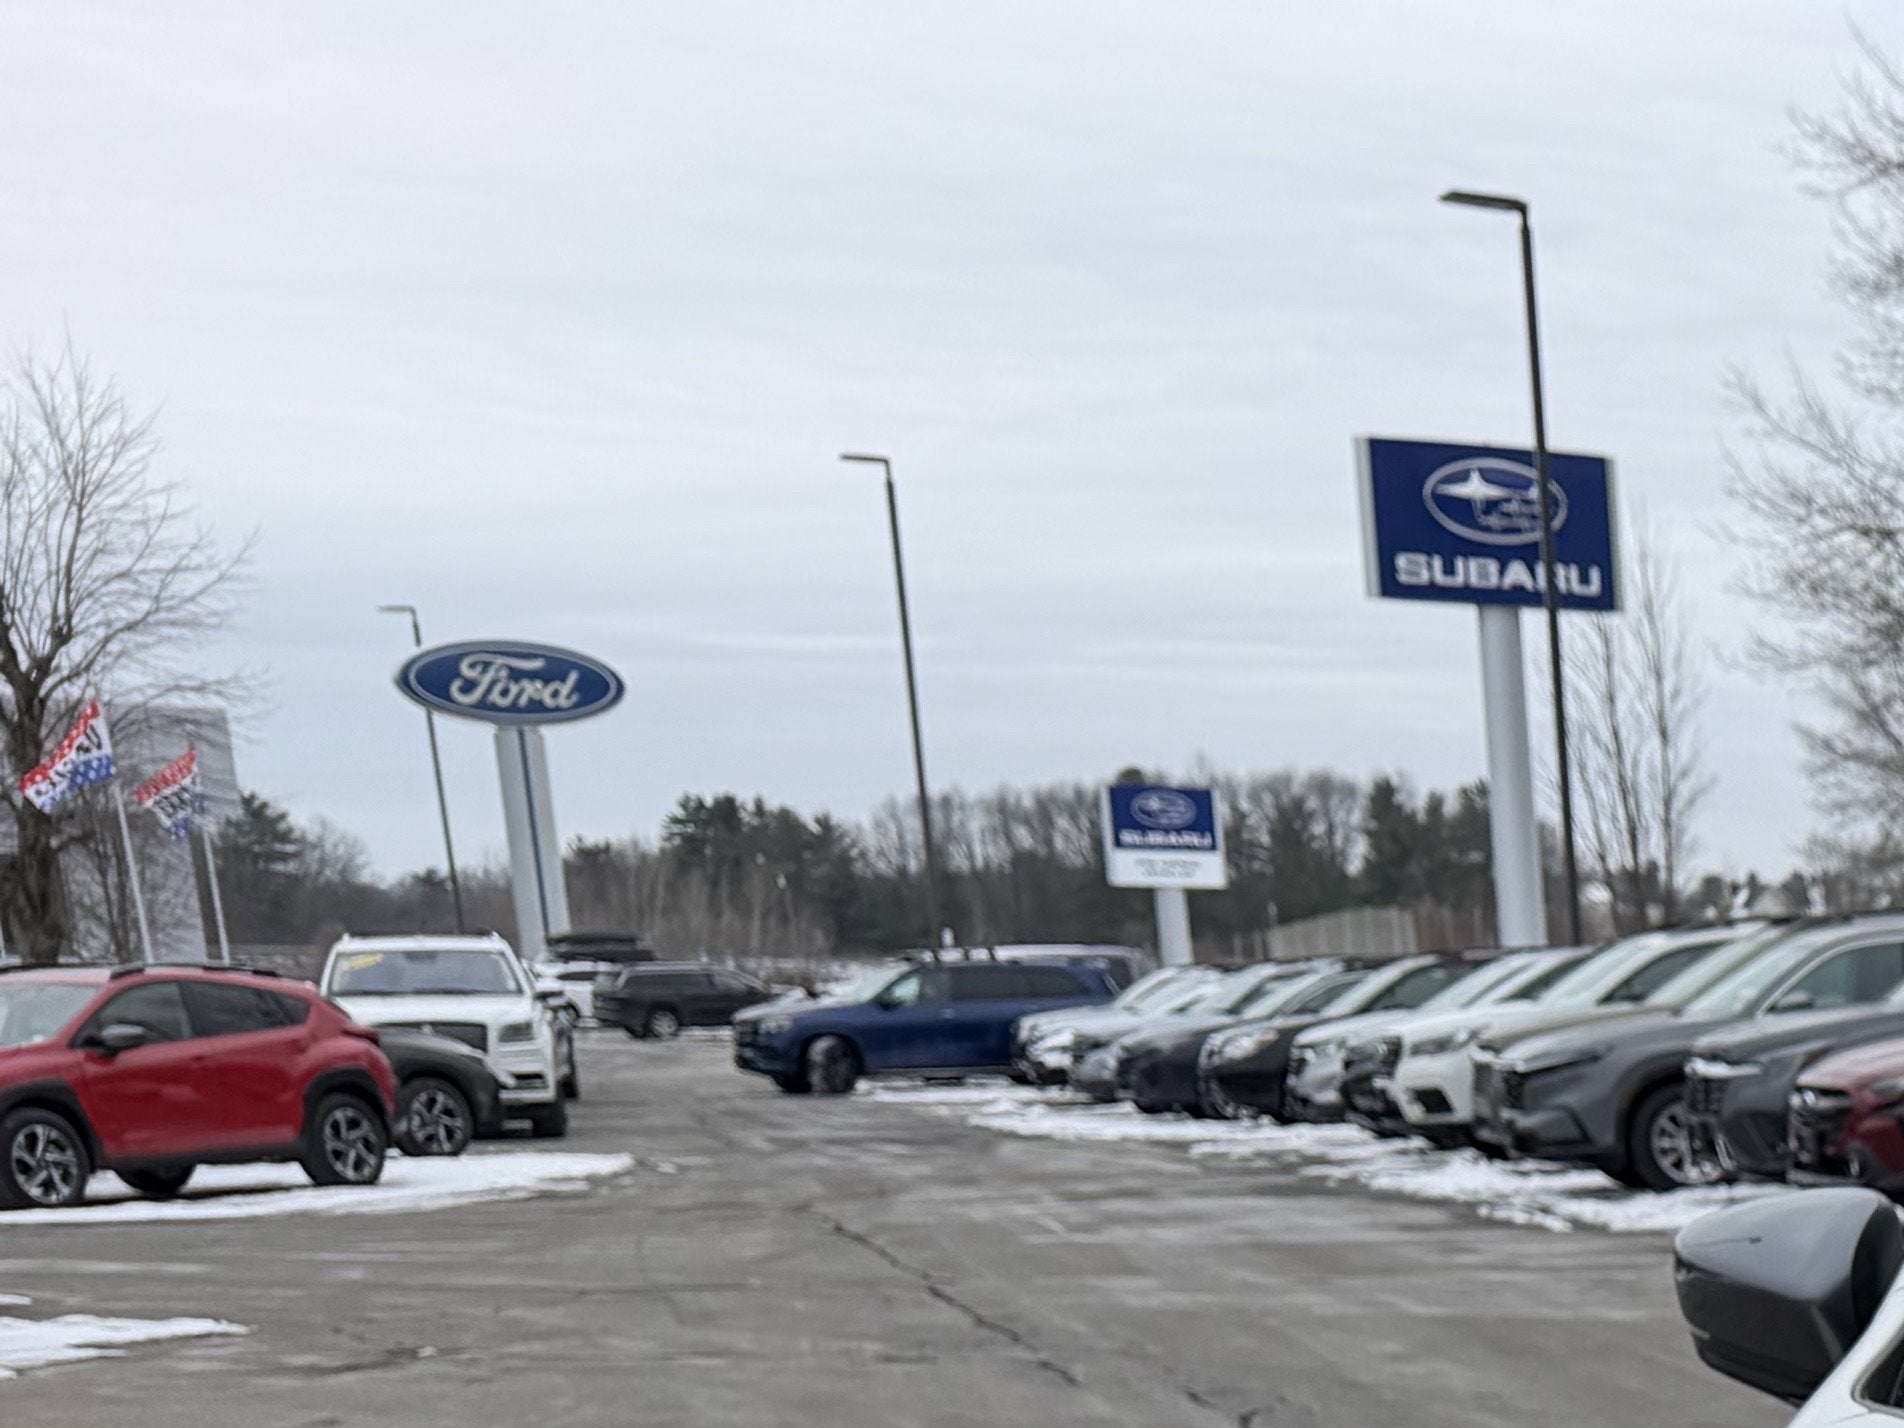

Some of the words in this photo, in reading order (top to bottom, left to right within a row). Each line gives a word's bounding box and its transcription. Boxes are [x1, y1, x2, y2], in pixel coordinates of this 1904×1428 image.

[1394, 551, 1602, 598] SUBARU
[450, 652, 580, 709] Ford
[1118, 828, 1214, 847] SUBARU
